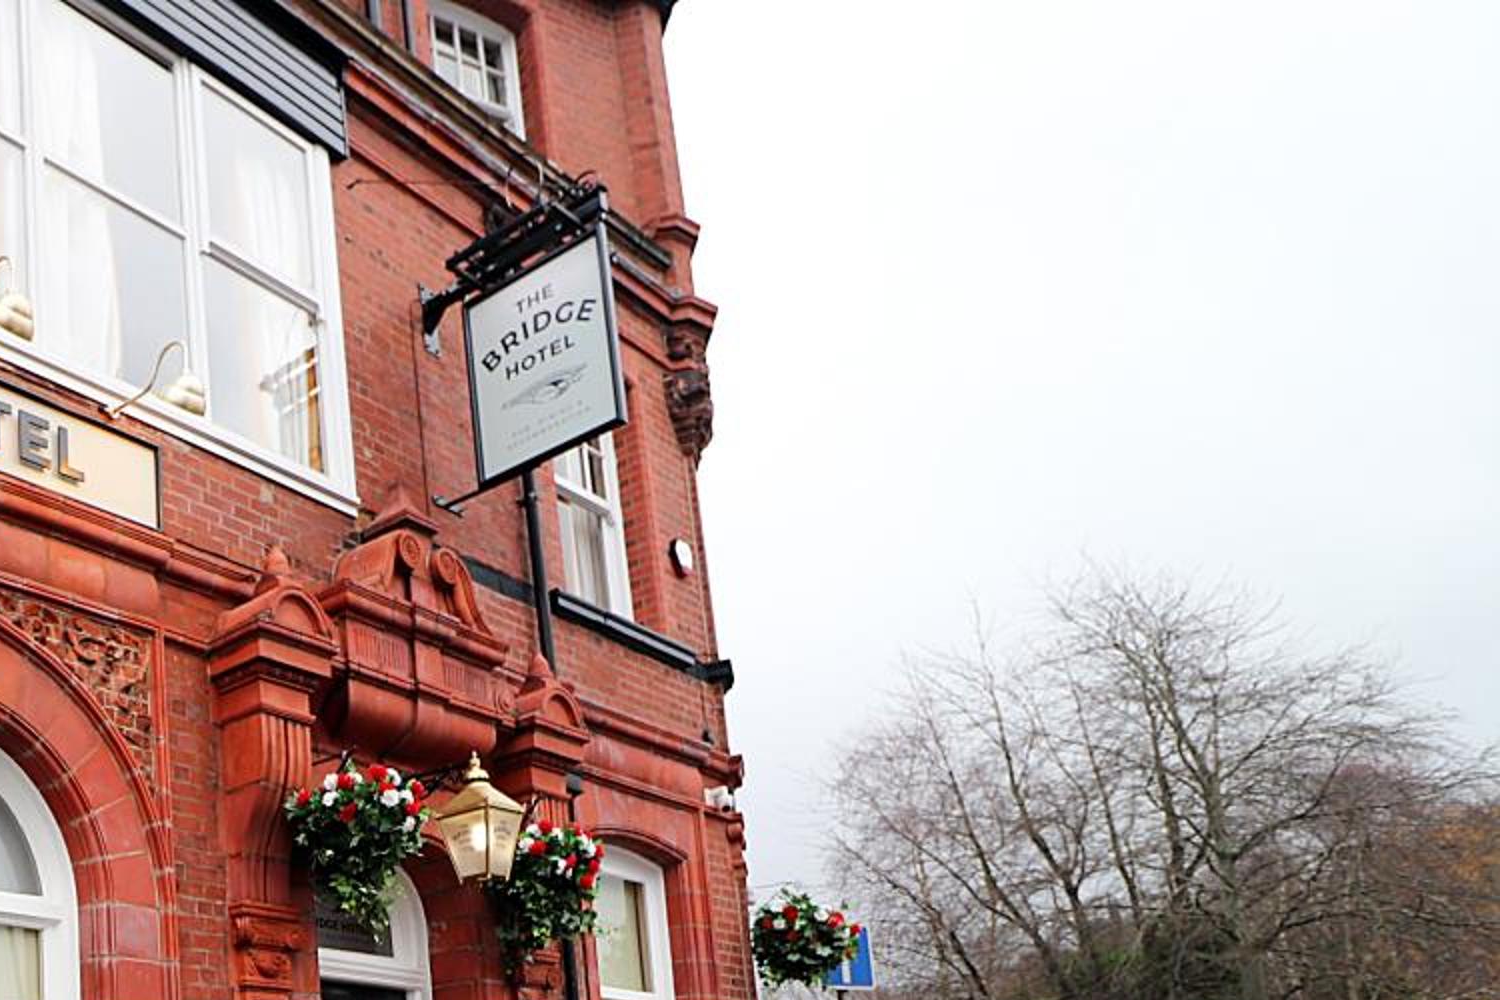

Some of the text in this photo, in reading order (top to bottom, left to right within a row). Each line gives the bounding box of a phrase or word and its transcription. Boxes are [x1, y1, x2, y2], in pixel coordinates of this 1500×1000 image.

[516, 283, 554, 314] THE
[481, 299, 597, 373] BRIDGE
[505, 335, 576, 381] HOTEL
